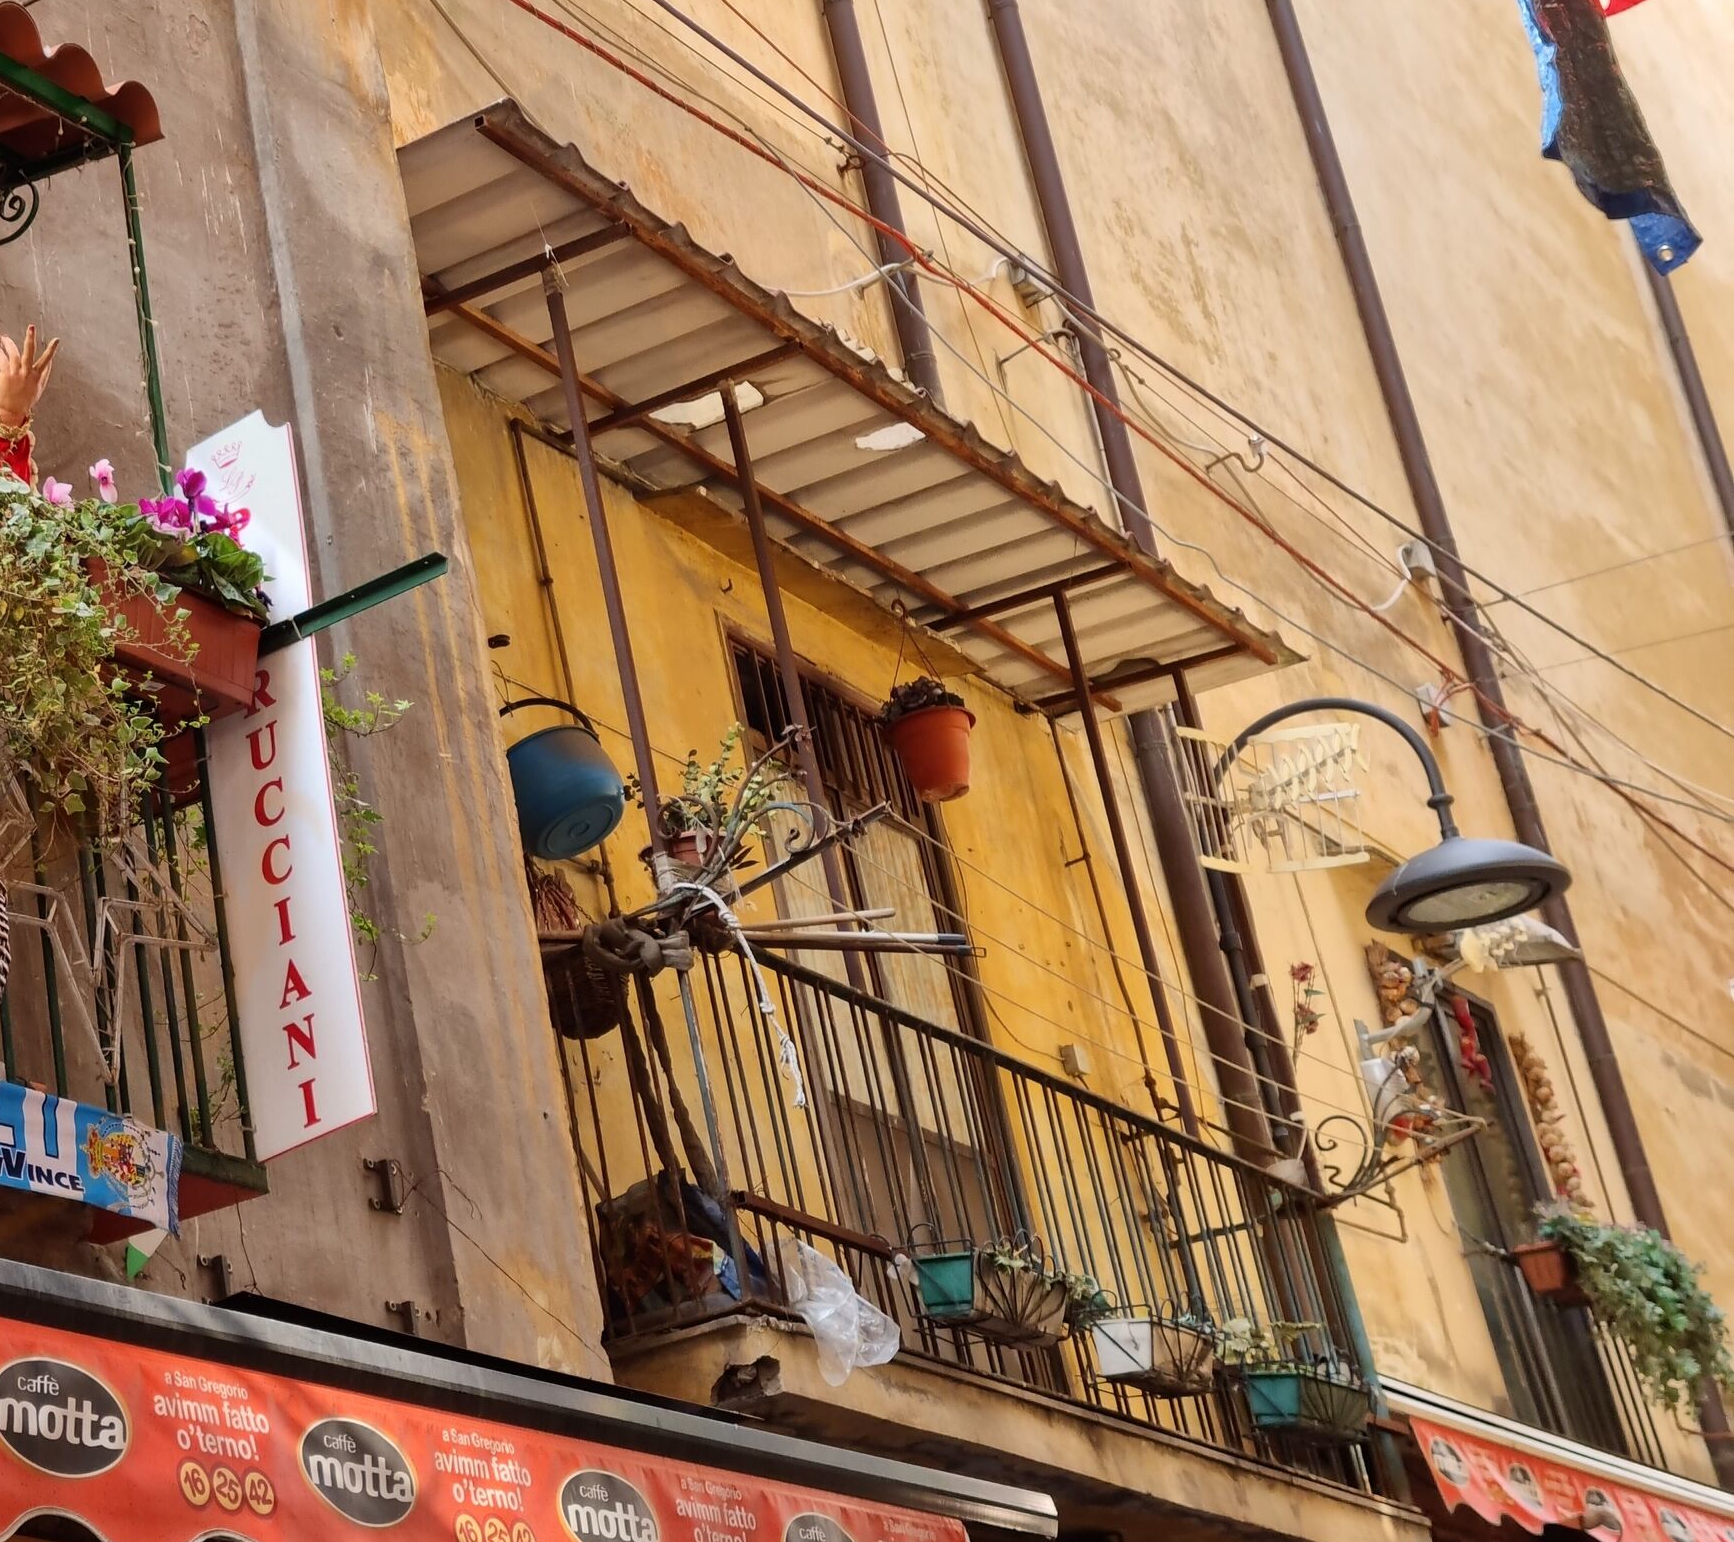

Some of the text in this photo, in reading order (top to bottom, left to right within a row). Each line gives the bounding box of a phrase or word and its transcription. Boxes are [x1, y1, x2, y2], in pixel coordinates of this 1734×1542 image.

[244, 670, 322, 1130] RUCCIANI
[17, 1374, 60, 1397] caffè
[164, 1370, 249, 1402] a San Gregorio
[153, 1393, 271, 1436] avimm fatto
[323, 1433, 357, 1455] caffè
[442, 1428, 516, 1456] a San Gregorio
[308, 1453, 417, 1504] motta
[434, 1450, 532, 1488] avimm fatto
[183, 1467, 273, 1506] 16 25 42
[579, 1483, 609, 1502] caffè
[722, 1502, 757, 1531] fatto
